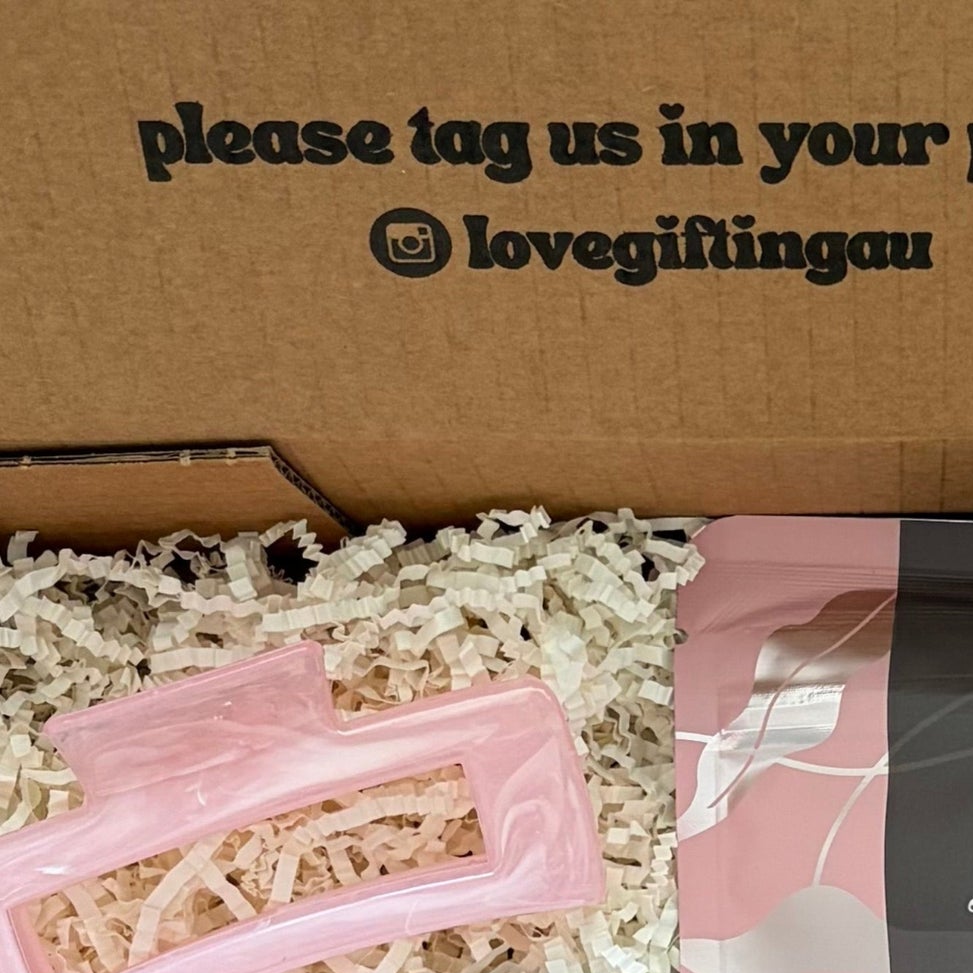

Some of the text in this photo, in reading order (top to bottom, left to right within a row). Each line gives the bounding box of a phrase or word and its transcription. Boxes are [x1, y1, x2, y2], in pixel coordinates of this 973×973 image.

[138, 102, 394, 182] please
[408, 106, 532, 183] tag
[549, 121, 643, 167] us
[660, 103, 744, 167] in
[759, 121, 950, 183] your
[463, 214, 934, 287] lovegiftingau
